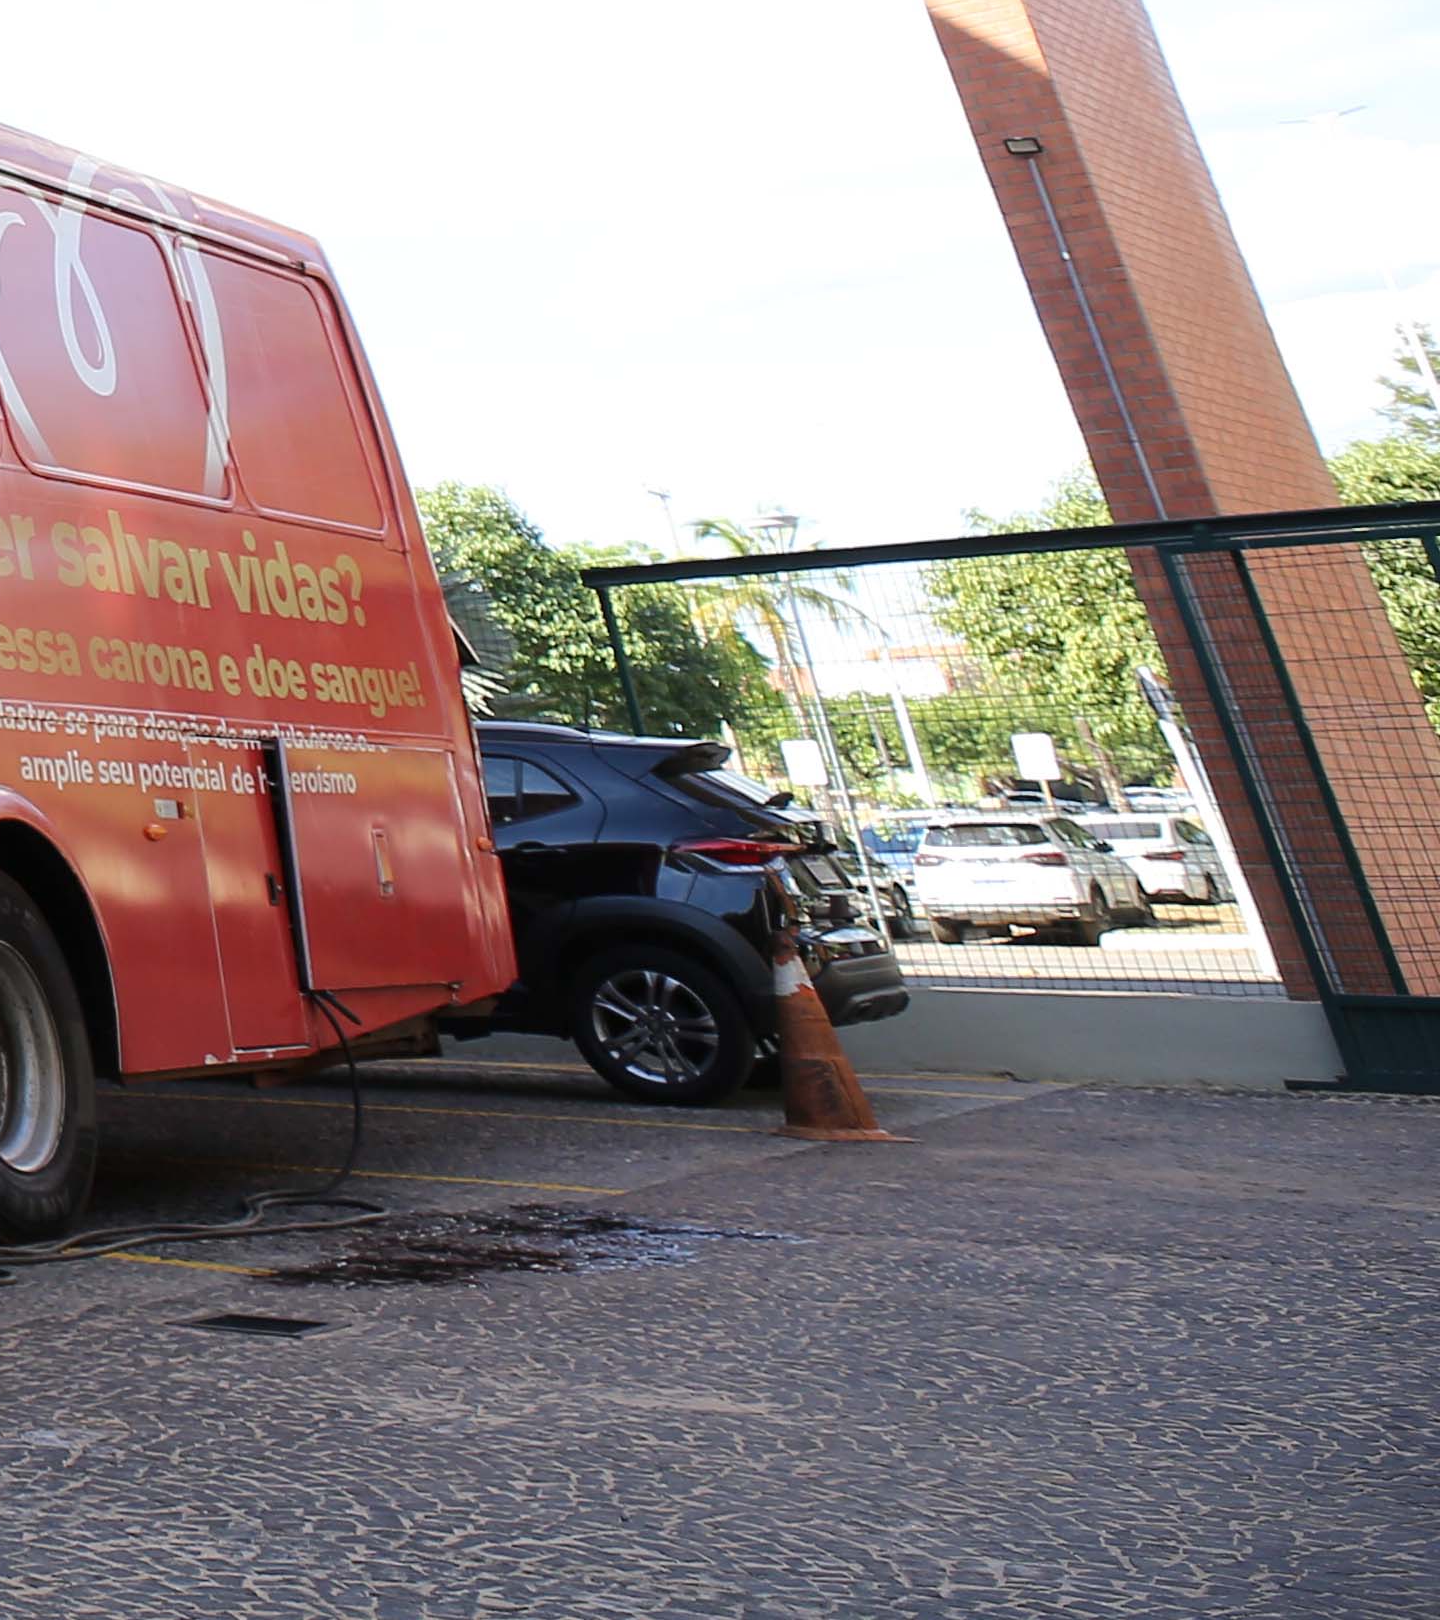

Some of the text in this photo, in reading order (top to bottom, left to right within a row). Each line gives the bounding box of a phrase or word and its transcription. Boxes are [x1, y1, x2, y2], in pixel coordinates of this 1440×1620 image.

[50, 509, 211, 609] salvar
[218, 529, 367, 627] vidas?
[88, 634, 215, 693] carona
[218, 653, 242, 697] e
[245, 643, 308, 700] doe
[309, 661, 426, 719] sangue!
[93, 712, 138, 744] para
[19, 750, 94, 790] amplie
[98, 759, 134, 785] seu
[139, 759, 228, 793] potencial
[232, 764, 255, 794] de
